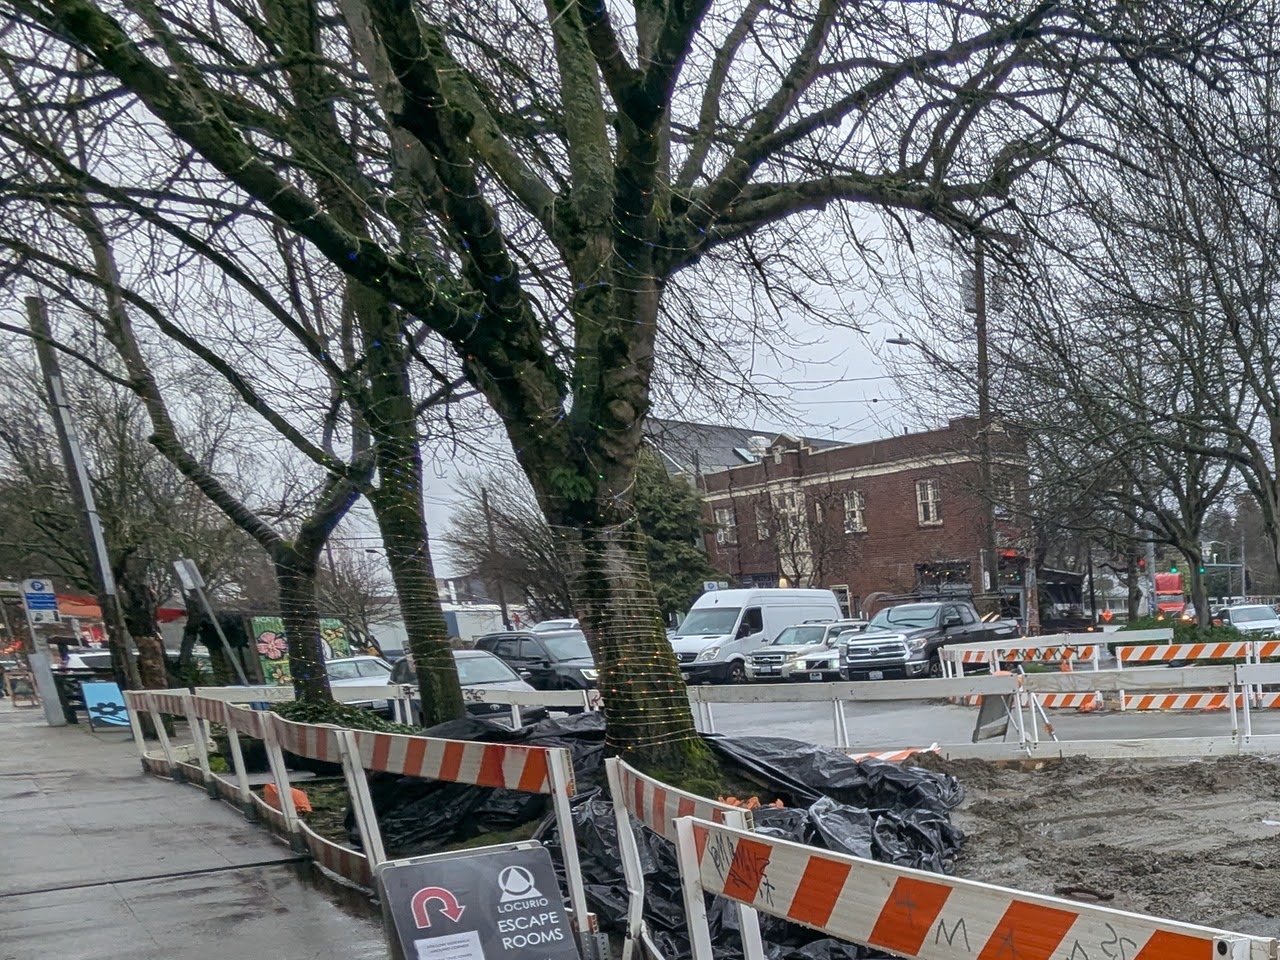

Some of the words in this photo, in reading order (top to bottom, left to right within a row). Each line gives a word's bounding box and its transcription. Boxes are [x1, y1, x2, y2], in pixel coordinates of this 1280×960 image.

[497, 898, 549, 914] LOCURIO
[497, 911, 560, 933] ESCAPE
[502, 928, 564, 950] ROOMS
